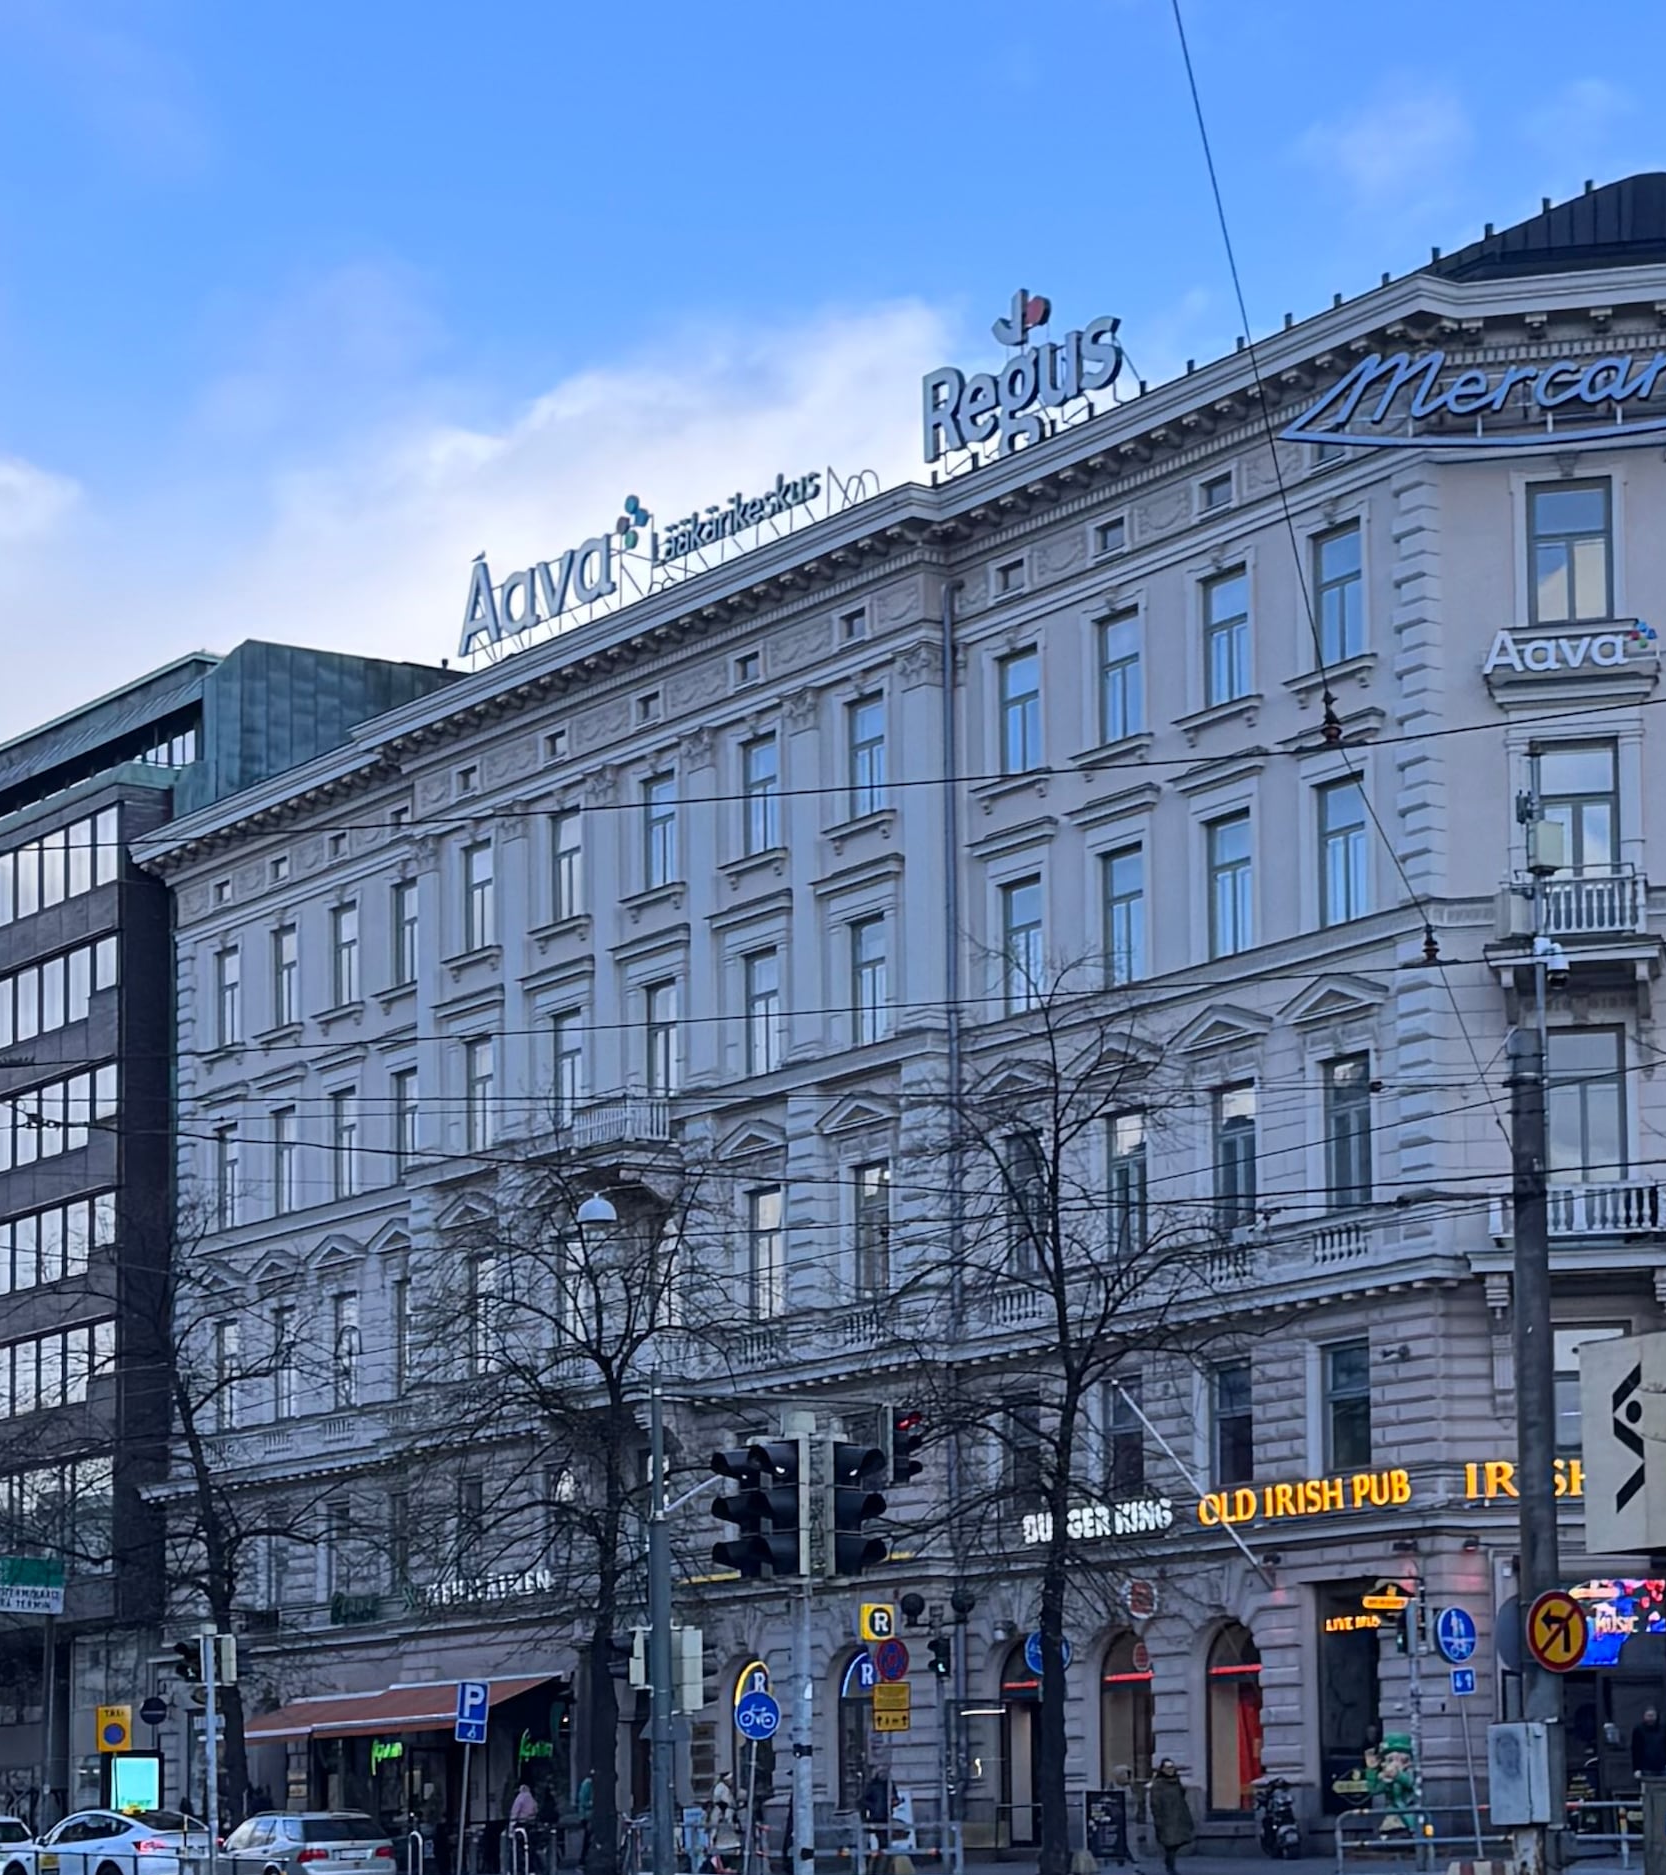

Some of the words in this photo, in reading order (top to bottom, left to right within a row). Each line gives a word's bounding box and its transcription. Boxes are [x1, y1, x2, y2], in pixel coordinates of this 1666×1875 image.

[923, 315, 1123, 464] Regus
[459, 533, 617, 657] Aava
[652, 472, 822, 562] Lääkärikeskus
[1483, 629, 1630, 676] Aava
[1198, 1488, 1256, 1526] OLD
[1265, 1477, 1344, 1518] IRISH
[1352, 1469, 1411, 1508] PUB
[1465, 1461, 1586, 1499] IRSH
[1023, 1505, 1111, 1544] BUGER
[873, 1612, 889, 1632] R
[463, 1684, 486, 1718] P
